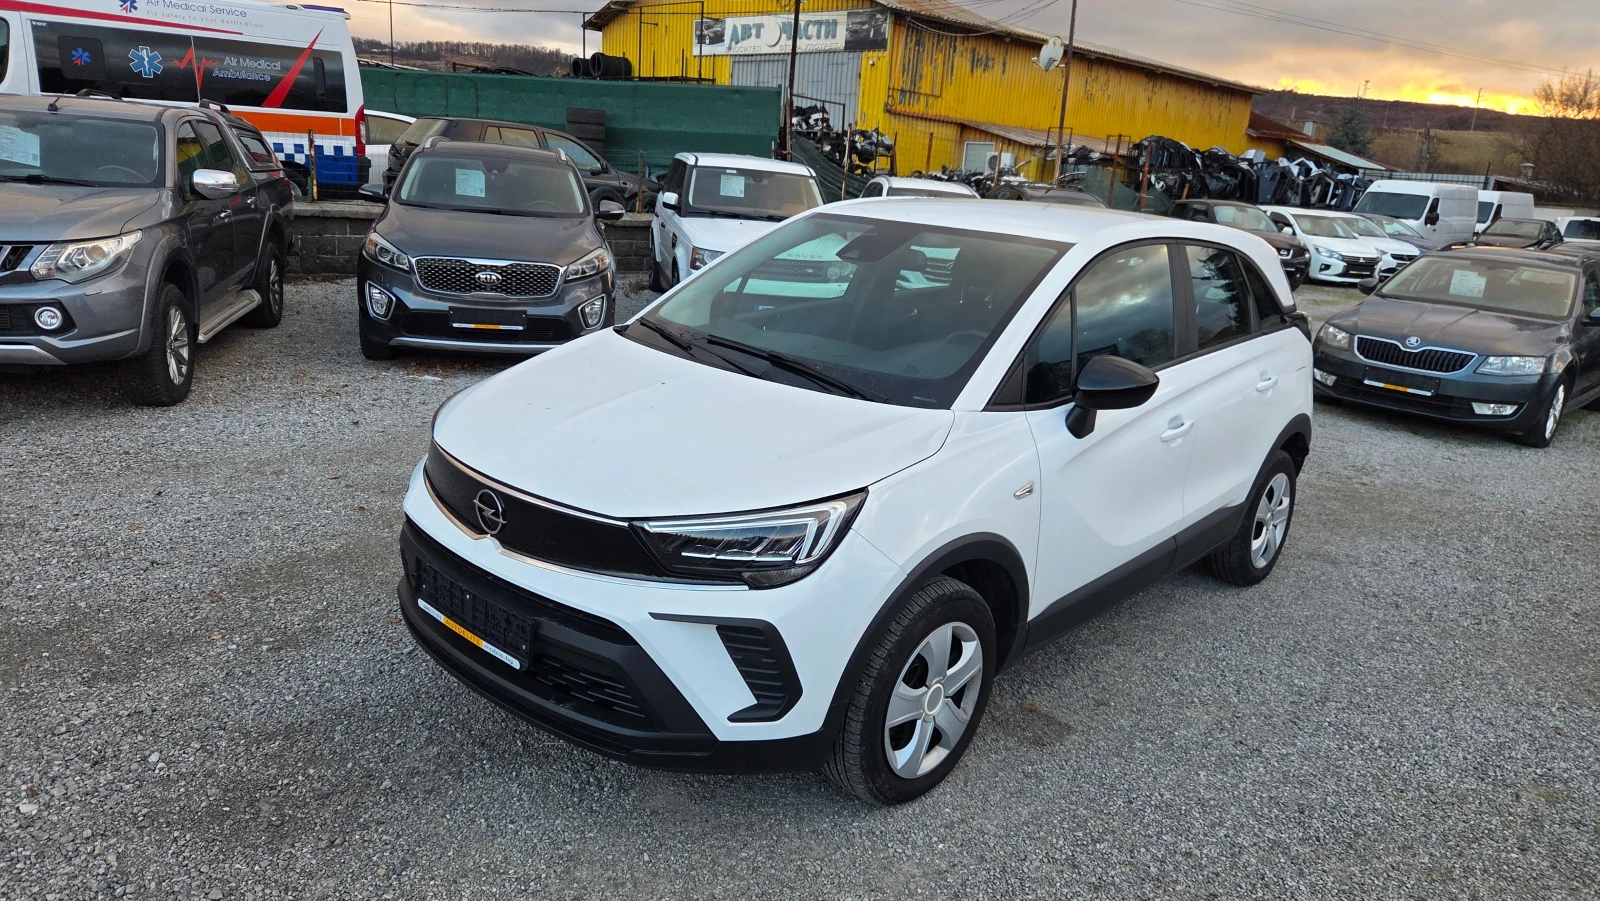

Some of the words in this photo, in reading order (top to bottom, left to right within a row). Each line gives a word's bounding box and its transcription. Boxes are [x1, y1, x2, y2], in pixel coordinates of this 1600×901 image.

[163, 0, 207, 13] Medical
[209, 5, 247, 18] Service
[161, 11, 186, 20] safely
[220, 18, 264, 28] destination
[224, 56, 238, 66] Air
[239, 57, 281, 71] Medical
[212, 67, 271, 82] Ambulance
[480, 274, 498, 283] KIA
[445, 618, 482, 646] AUTOELITE
